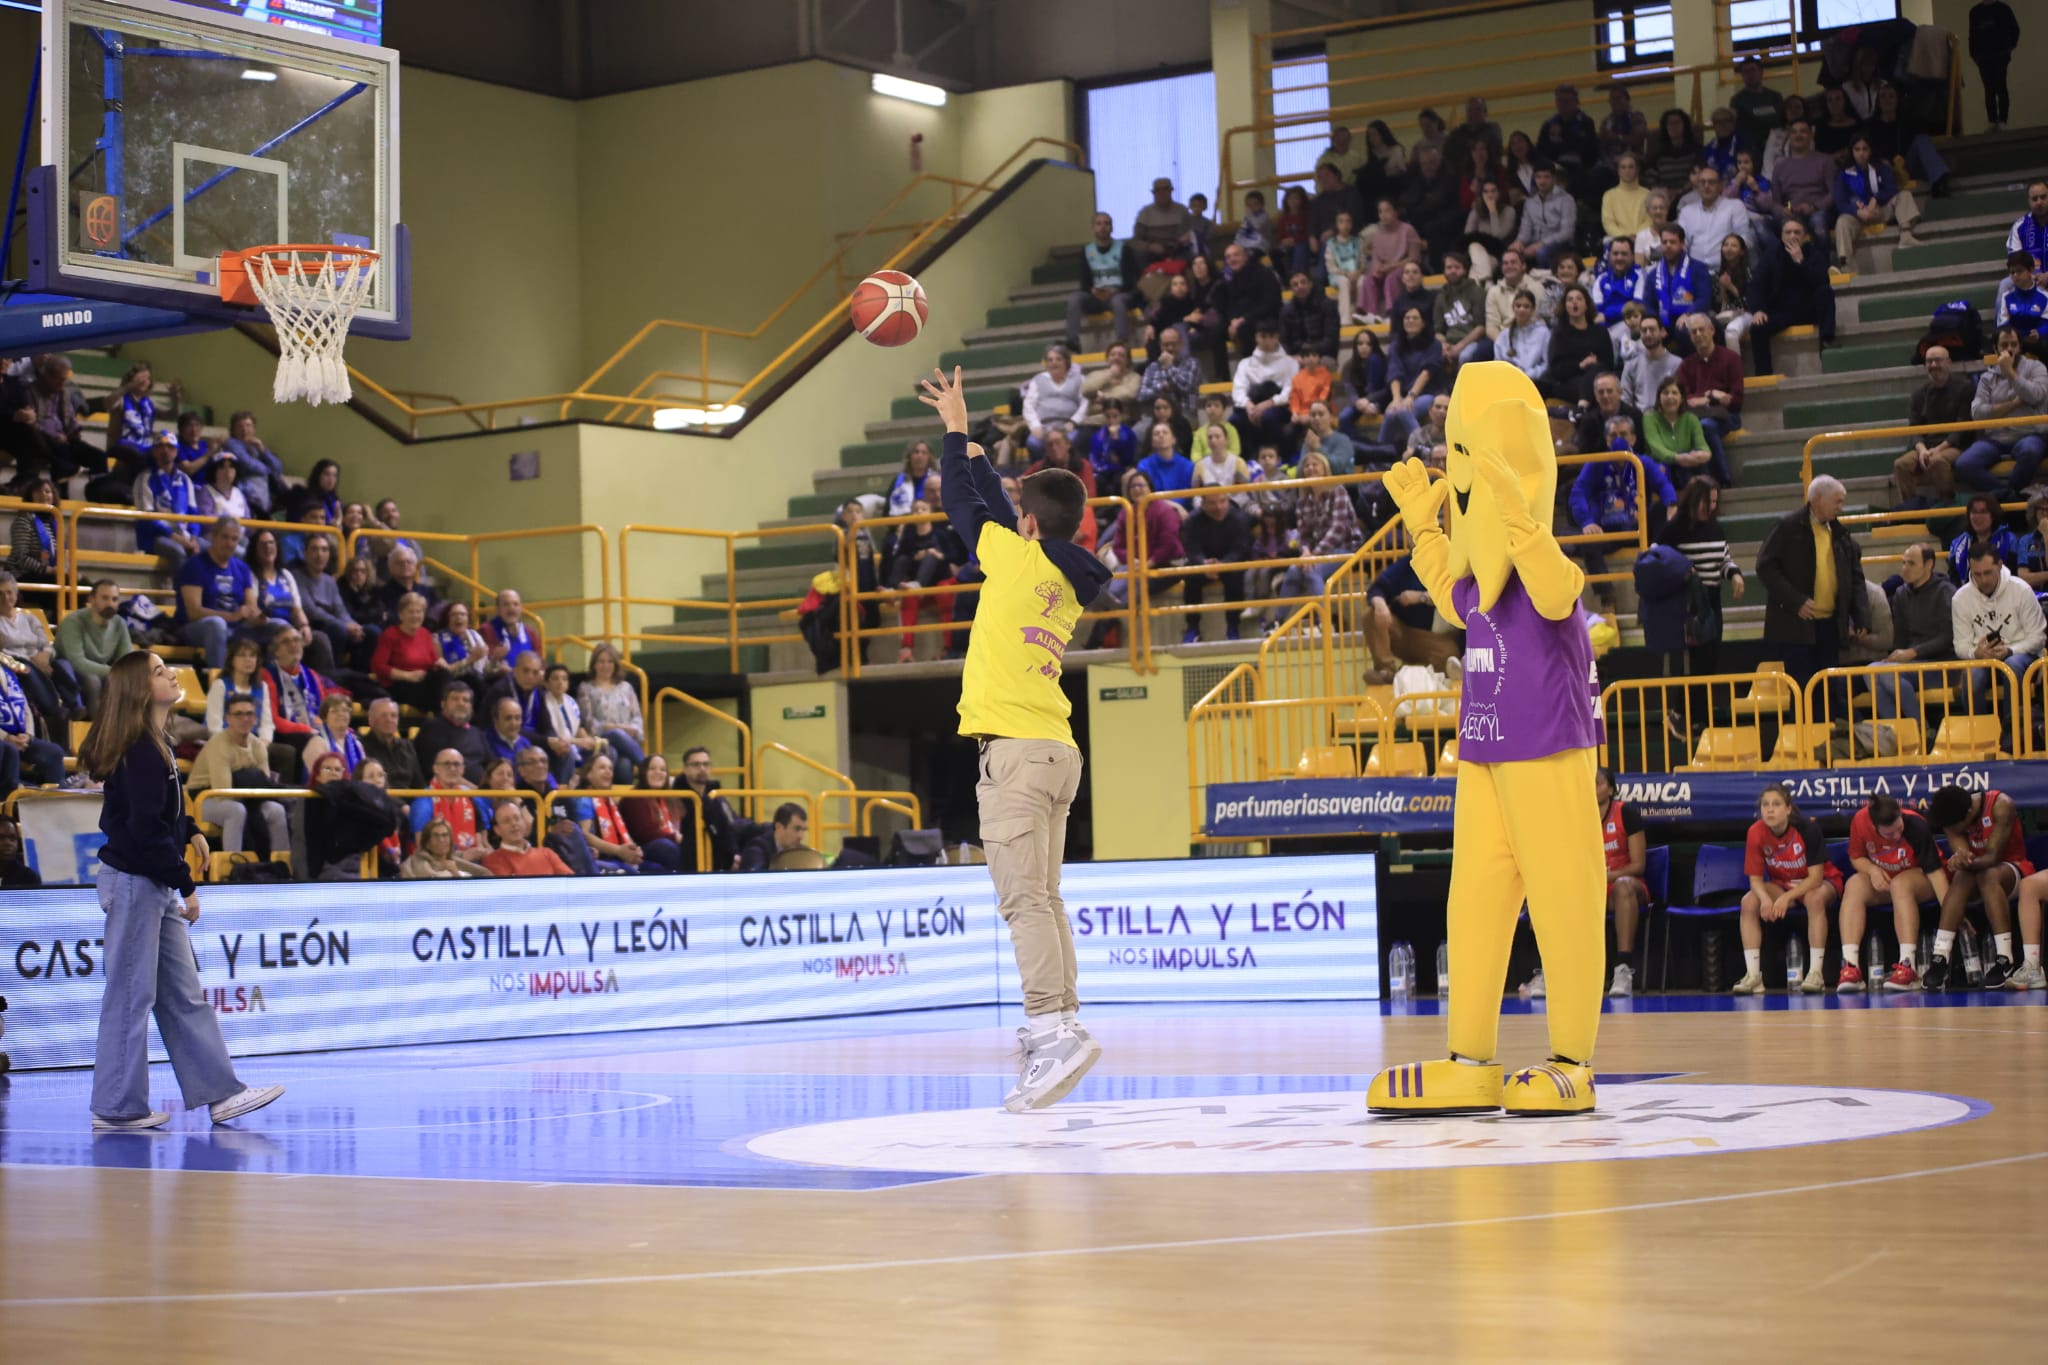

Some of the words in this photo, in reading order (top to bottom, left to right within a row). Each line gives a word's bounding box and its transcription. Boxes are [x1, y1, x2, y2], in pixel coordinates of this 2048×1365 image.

[42, 310, 92, 328] MONDO
[1615, 782, 1691, 802] MANCA
[1782, 775, 1890, 797] CASTILLA
[1902, 774, 1917, 797] Y
[1215, 791, 1452, 824] perfumeriasavenida.com
[740, 911, 864, 948] CASTILLA
[877, 909, 892, 947] Y
[904, 896, 965, 938] LEÓN
[1066, 904, 1191, 936] STILLA
[1211, 903, 1234, 940] Y
[1251, 889, 1345, 932] LEÓN
[219, 933, 243, 979] Y
[260, 917, 350, 968] LEÓN
[412, 923, 564, 962] CASTILLA
[581, 921, 600, 963] Y
[614, 907, 689, 953] LEÓN
[803, 957, 833, 975] NOS
[835, 952, 908, 983] IMPULSA
[1109, 948, 1147, 965] NOS
[1153, 946, 1257, 971] IMPULSA
[203, 985, 266, 1014] ULSA
[490, 973, 526, 993] NOS
[529, 968, 619, 1000] IMPULSA
